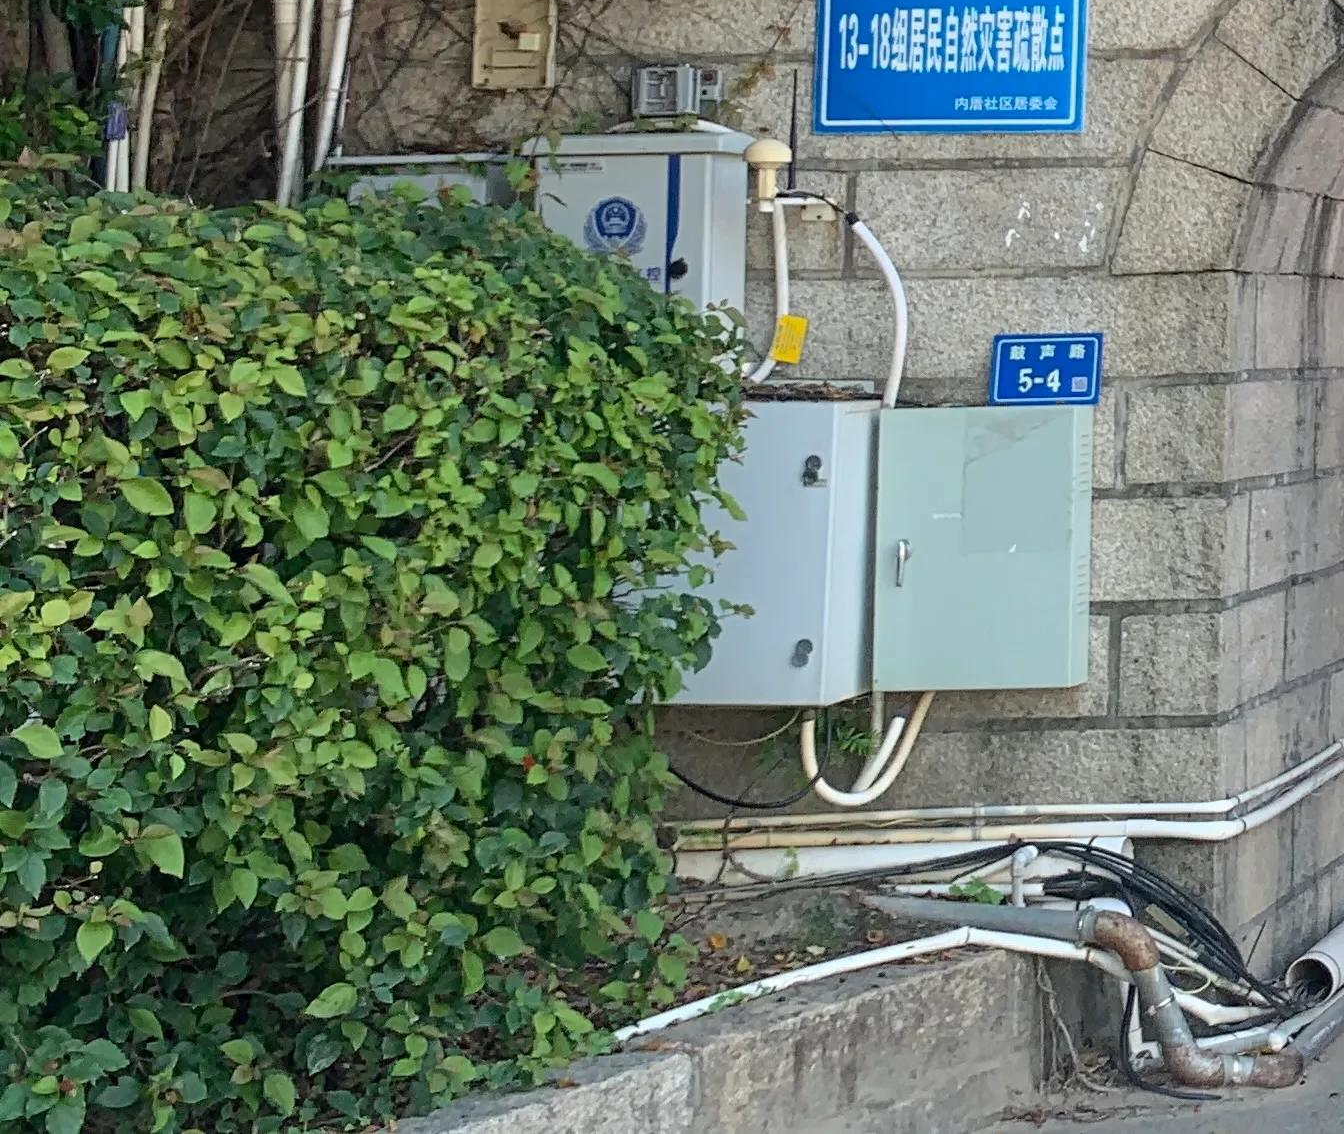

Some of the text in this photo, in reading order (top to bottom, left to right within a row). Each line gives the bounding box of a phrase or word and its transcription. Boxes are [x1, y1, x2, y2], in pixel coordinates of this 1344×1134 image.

[839, 5, 1065, 73] 13-18组居民自然灾害疏散点
[954, 96, 1058, 111] 内厝社区居委会
[1018, 368, 1061, 393] 5-4
